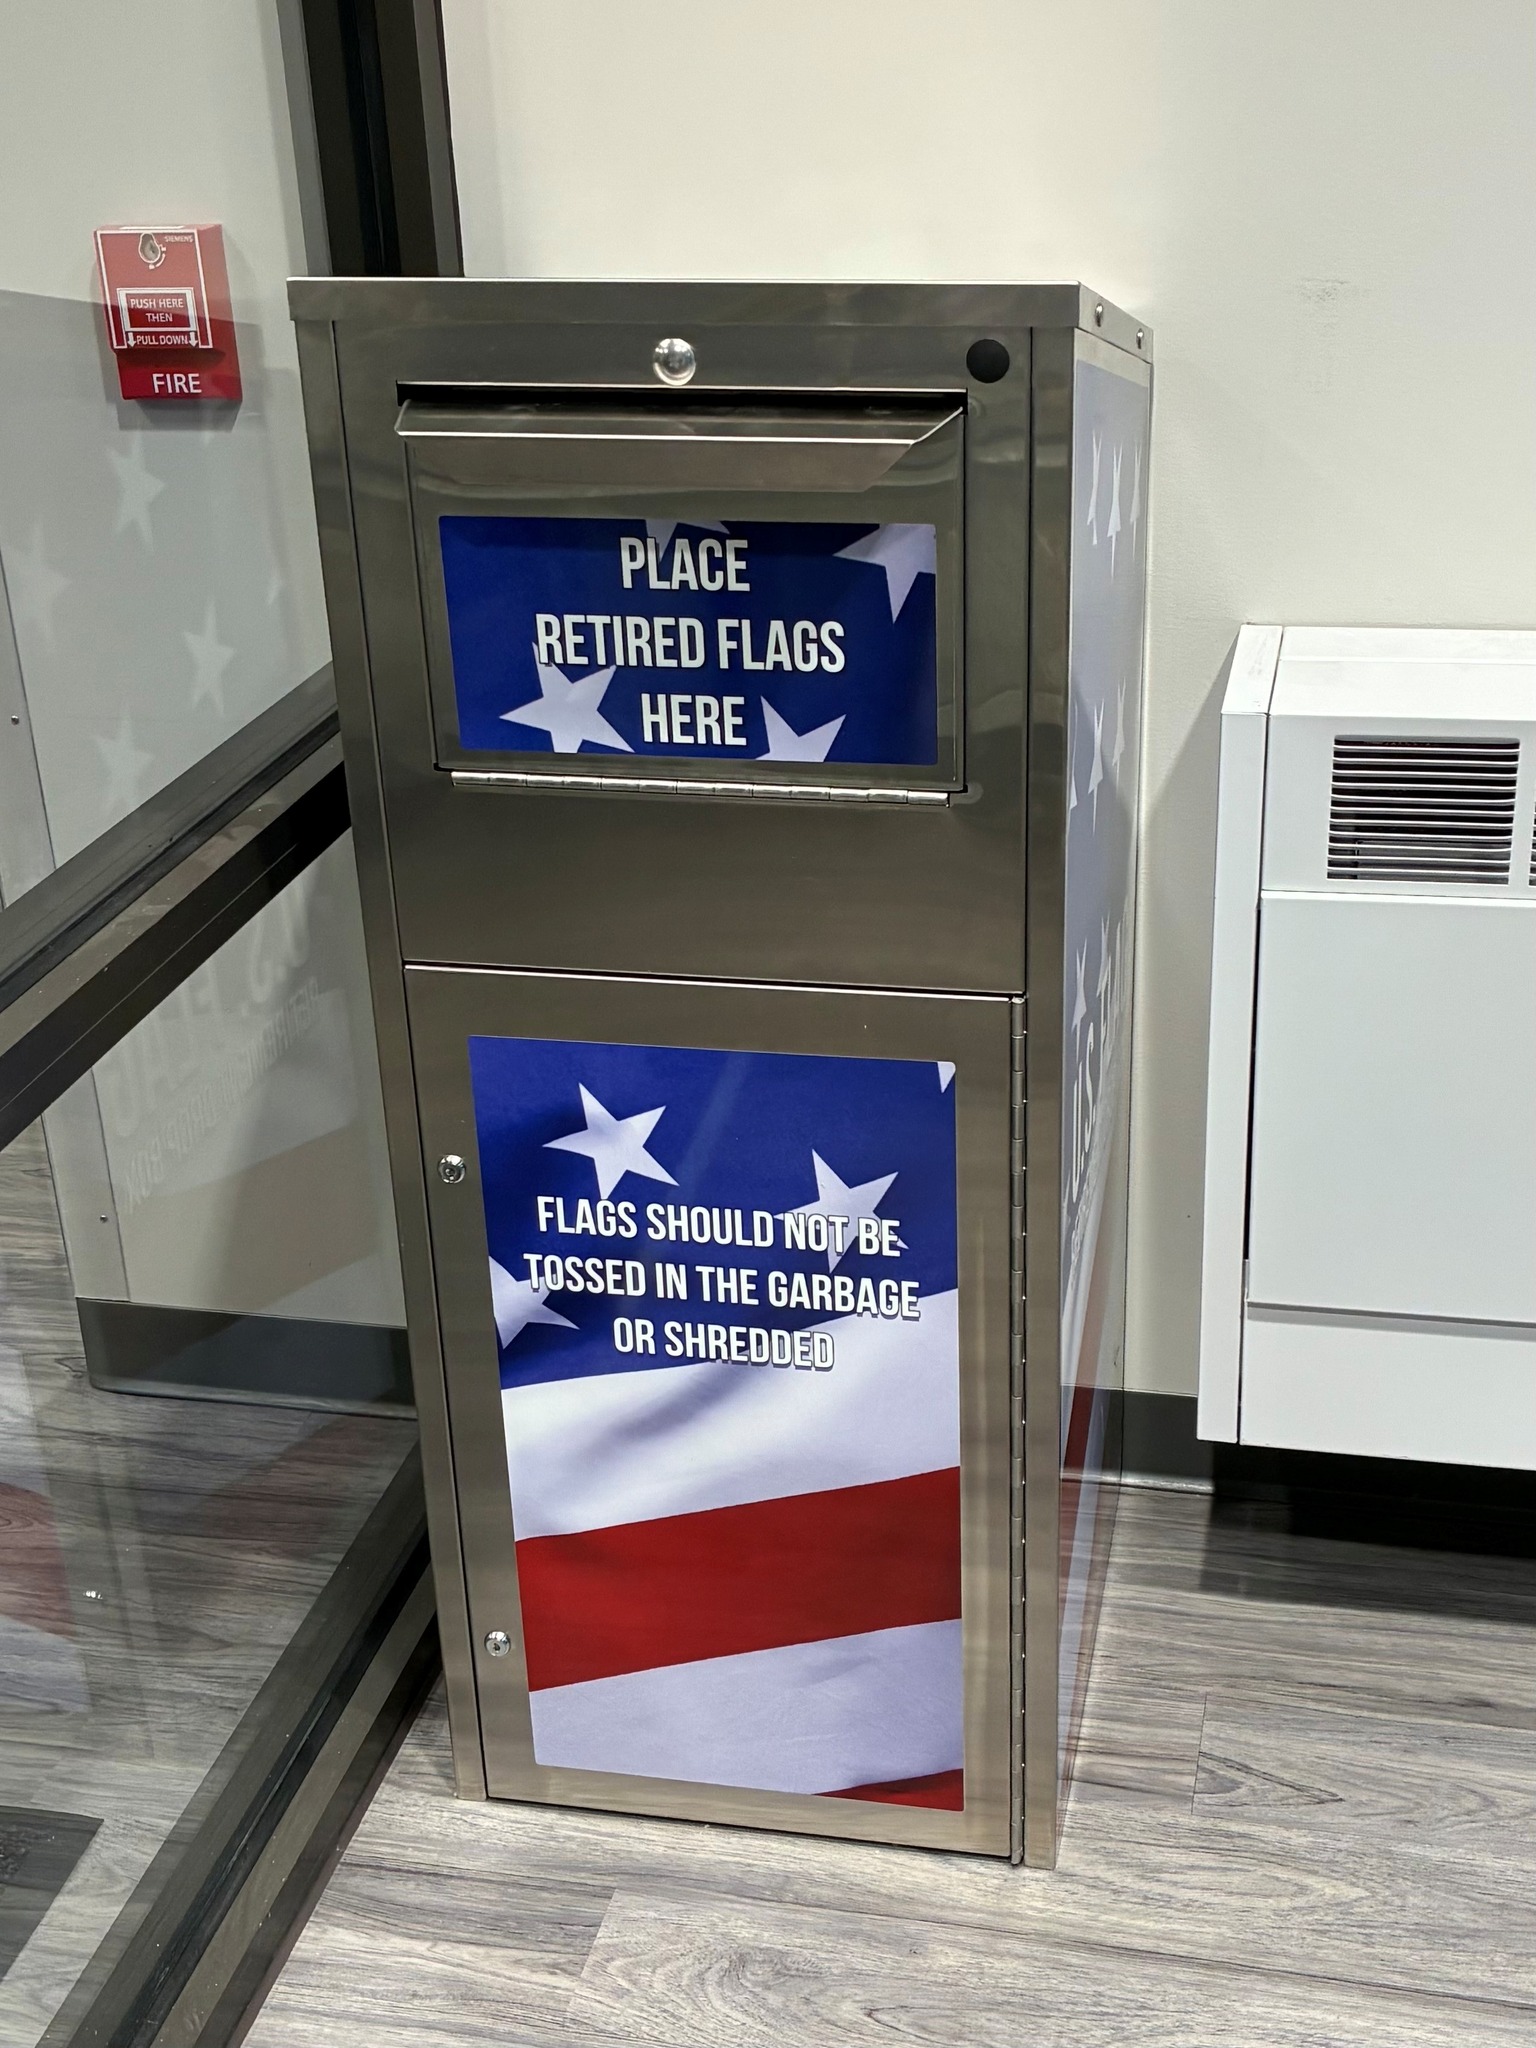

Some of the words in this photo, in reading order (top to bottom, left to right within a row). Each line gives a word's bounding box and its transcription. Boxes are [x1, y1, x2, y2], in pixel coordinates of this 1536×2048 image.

[130, 298, 156, 309] PUSH
[158, 298, 184, 308] HERE
[145, 312, 173, 323] THEN
[136, 335, 158, 345] PULL
[159, 335, 188, 345] DOWN
[152, 373, 202, 394] FIRE
[619, 536, 751, 592] PLACE
[535, 612, 706, 669] RETIRED
[717, 618, 846, 673] FLAGS
[641, 692, 747, 746] HERE
[536, 1195, 639, 1239] FLAGS
[646, 1201, 775, 1248] SHOULD
[783, 1211, 850, 1255] NOT
[858, 1218, 902, 1258] BE
[523, 1252, 647, 1298] TOSSED
[655, 1261, 688, 1300] IN
[695, 1264, 760, 1306] THE
[768, 1269, 922, 1319] GARBAGE
[612, 1316, 656, 1355] OR
[664, 1321, 836, 1371] SHREDDED
